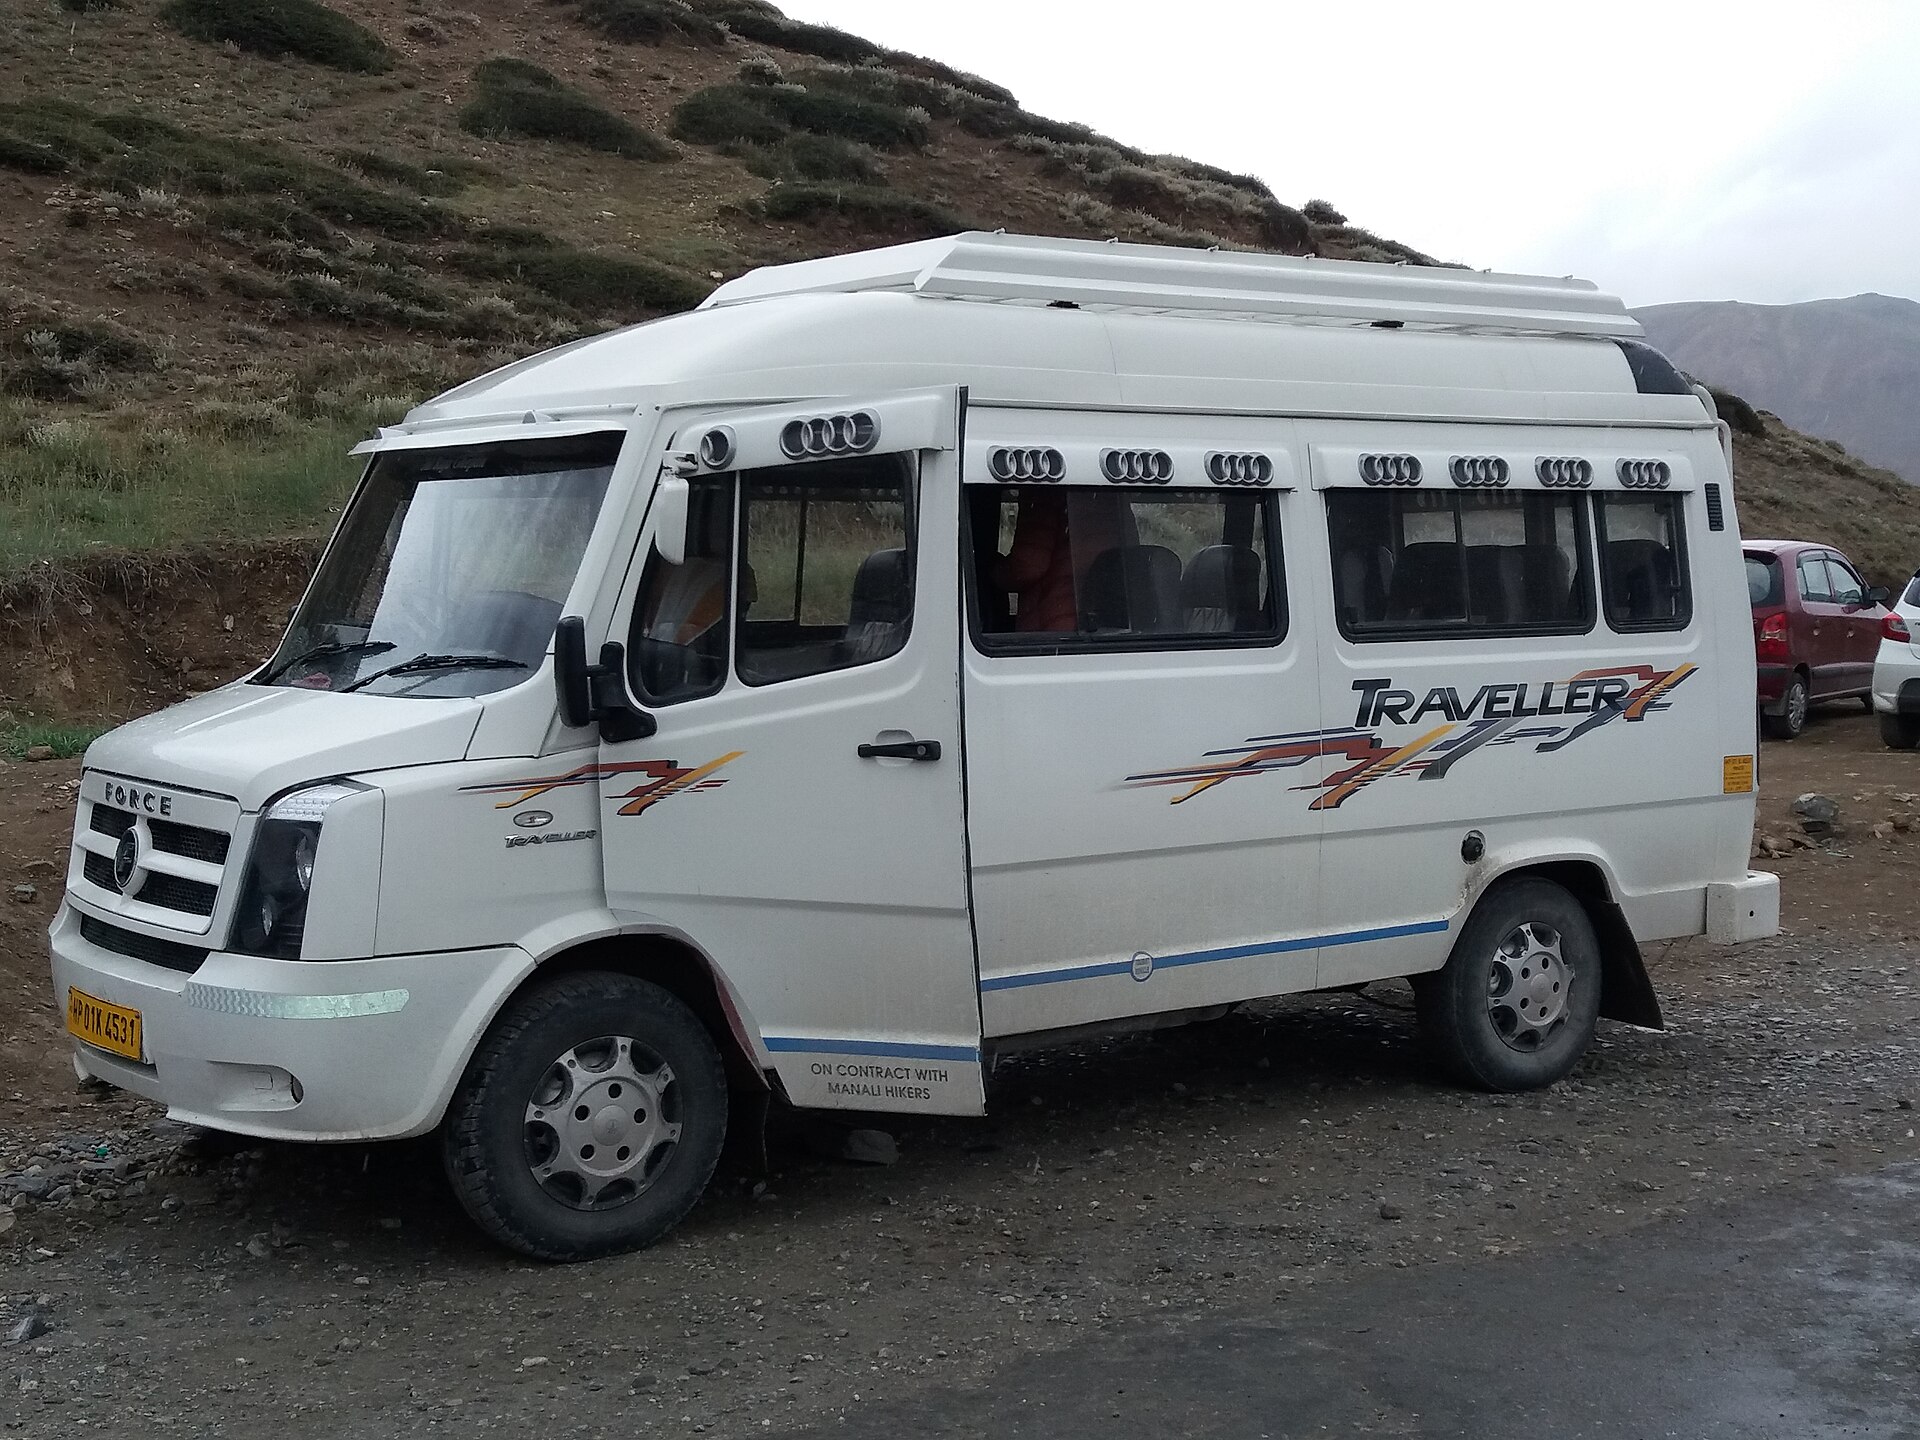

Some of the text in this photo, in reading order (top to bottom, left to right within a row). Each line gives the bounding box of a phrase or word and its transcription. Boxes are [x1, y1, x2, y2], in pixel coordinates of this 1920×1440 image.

[1351, 678, 1630, 728] TRAVELLER
[105, 781, 172, 817] FORCE
[104, 1011, 135, 1048] 4531
[811, 1063, 949, 1083] ON CONTRACT WITH
[827, 1082, 931, 1100] MANALI HIKERS
